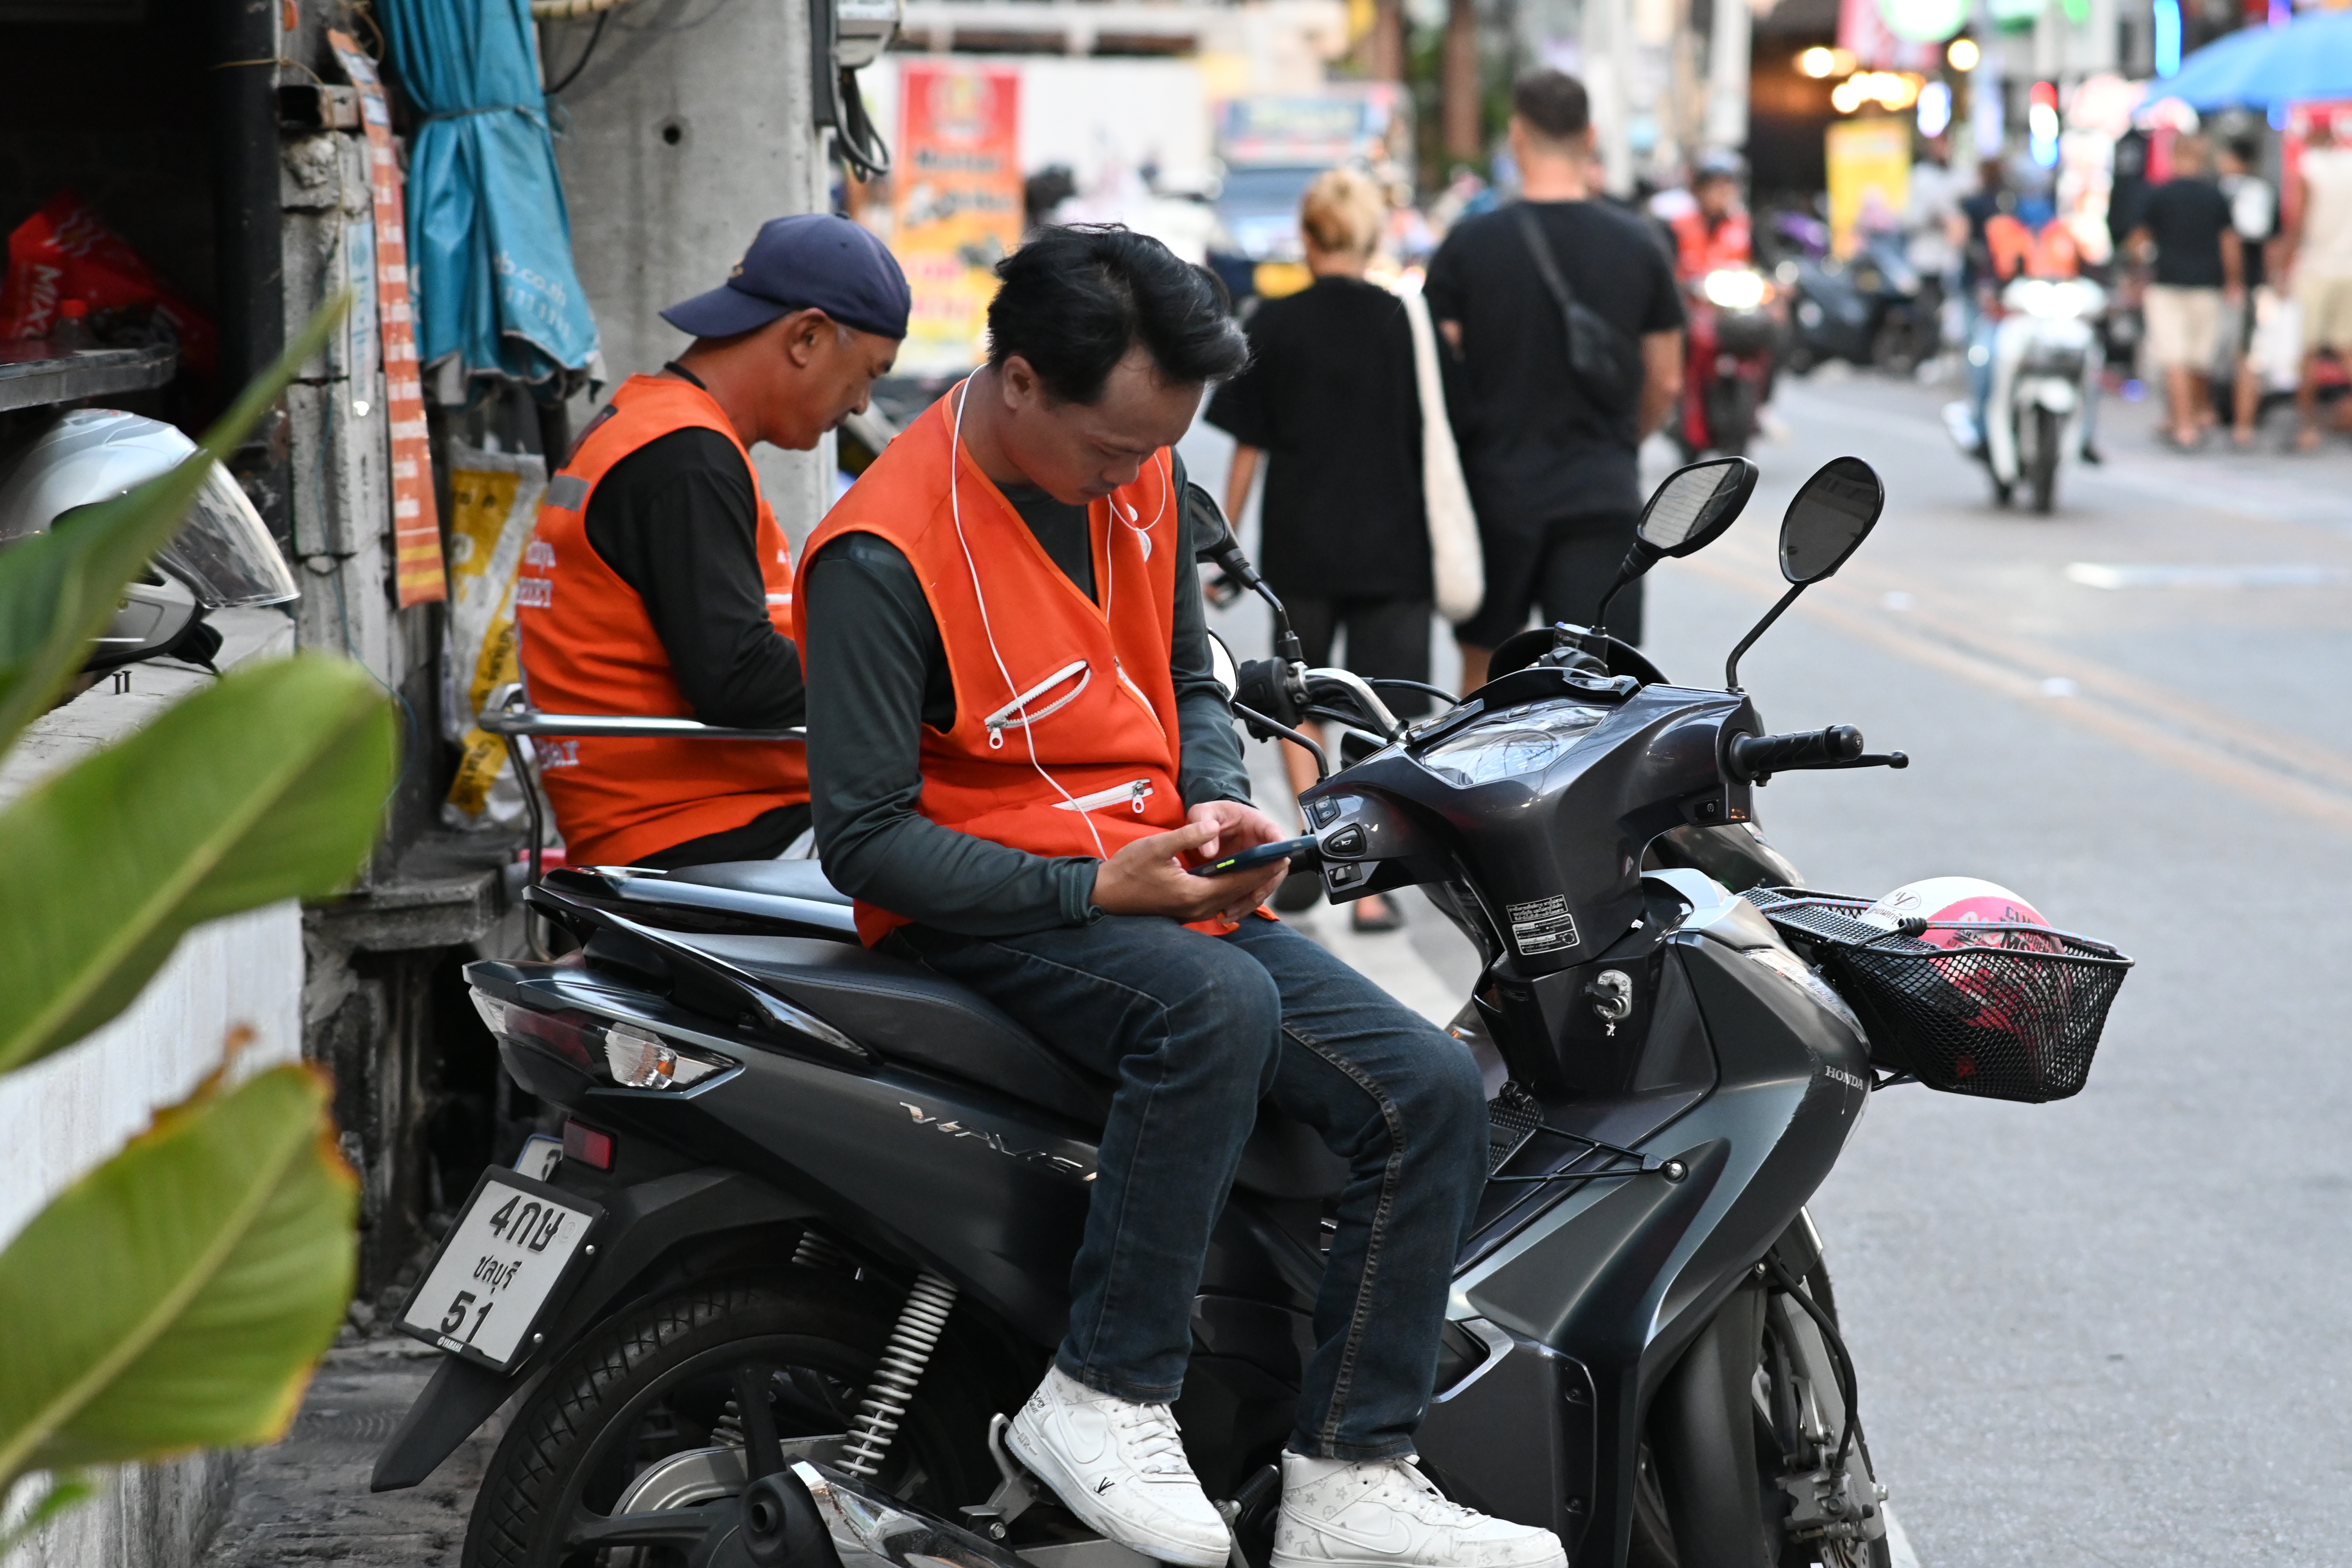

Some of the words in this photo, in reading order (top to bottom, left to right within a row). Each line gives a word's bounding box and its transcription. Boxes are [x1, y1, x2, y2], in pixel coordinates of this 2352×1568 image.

[1825, 1065, 1863, 1090] HONDA
[473, 1255, 523, 1294] ชลบุรี
[441, 1290, 494, 1343] 51
[441, 1338, 464, 1353] YAMAHA
